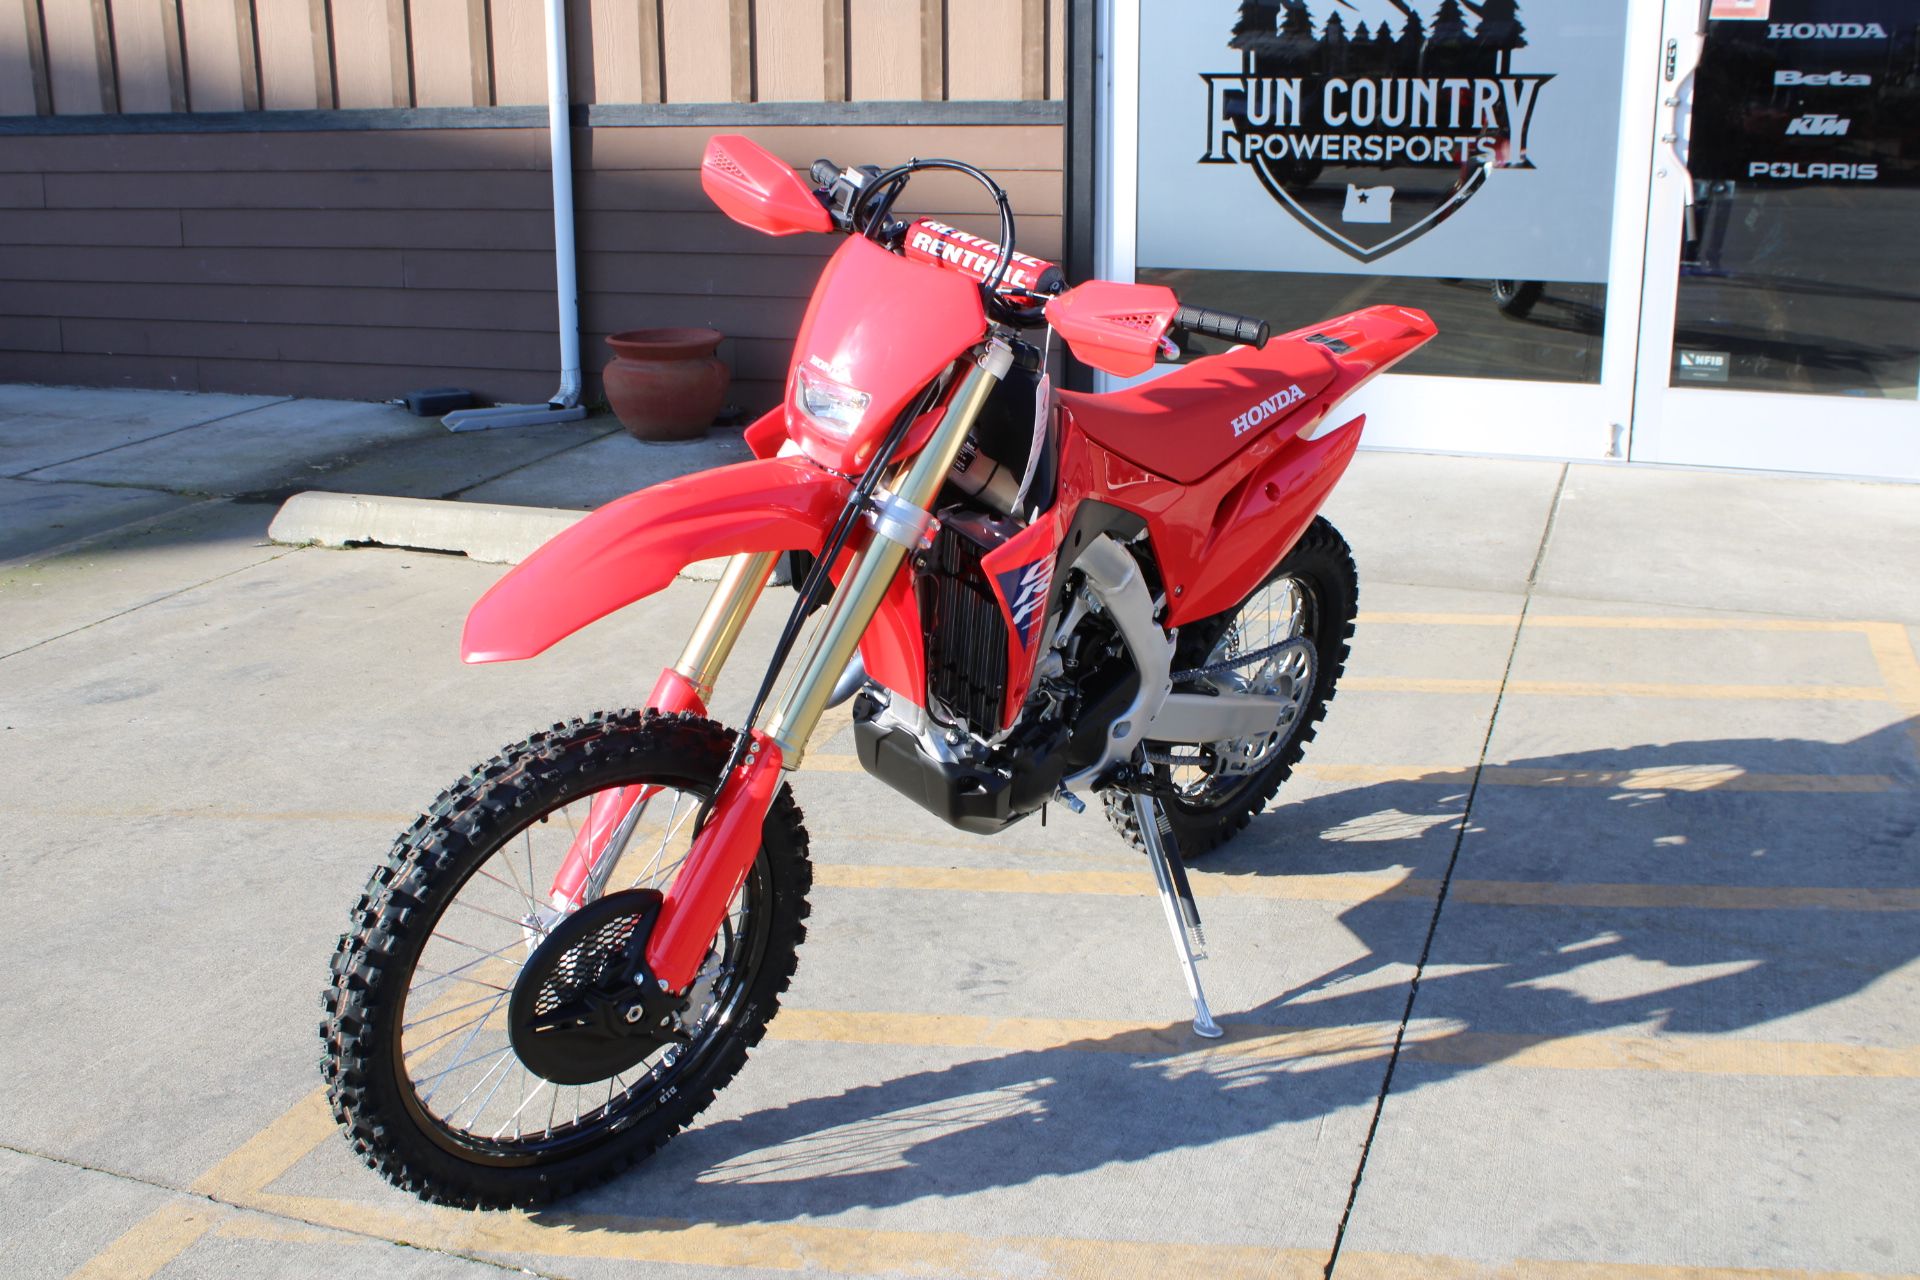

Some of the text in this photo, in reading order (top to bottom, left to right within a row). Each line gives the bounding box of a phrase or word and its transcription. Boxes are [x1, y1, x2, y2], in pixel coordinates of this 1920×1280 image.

[1767, 23, 1888, 39] HONDA
[1774, 70, 1872, 86] Beta
[1208, 77, 1540, 165] FUN COUNTRY
[1785, 113, 1851, 136] KTM
[1244, 133, 1497, 163] POWERSPORTS
[1749, 162, 1878, 180] POLARIS
[1695, 354, 1724, 366] NFIB
[1230, 383, 1306, 438] HONDA
